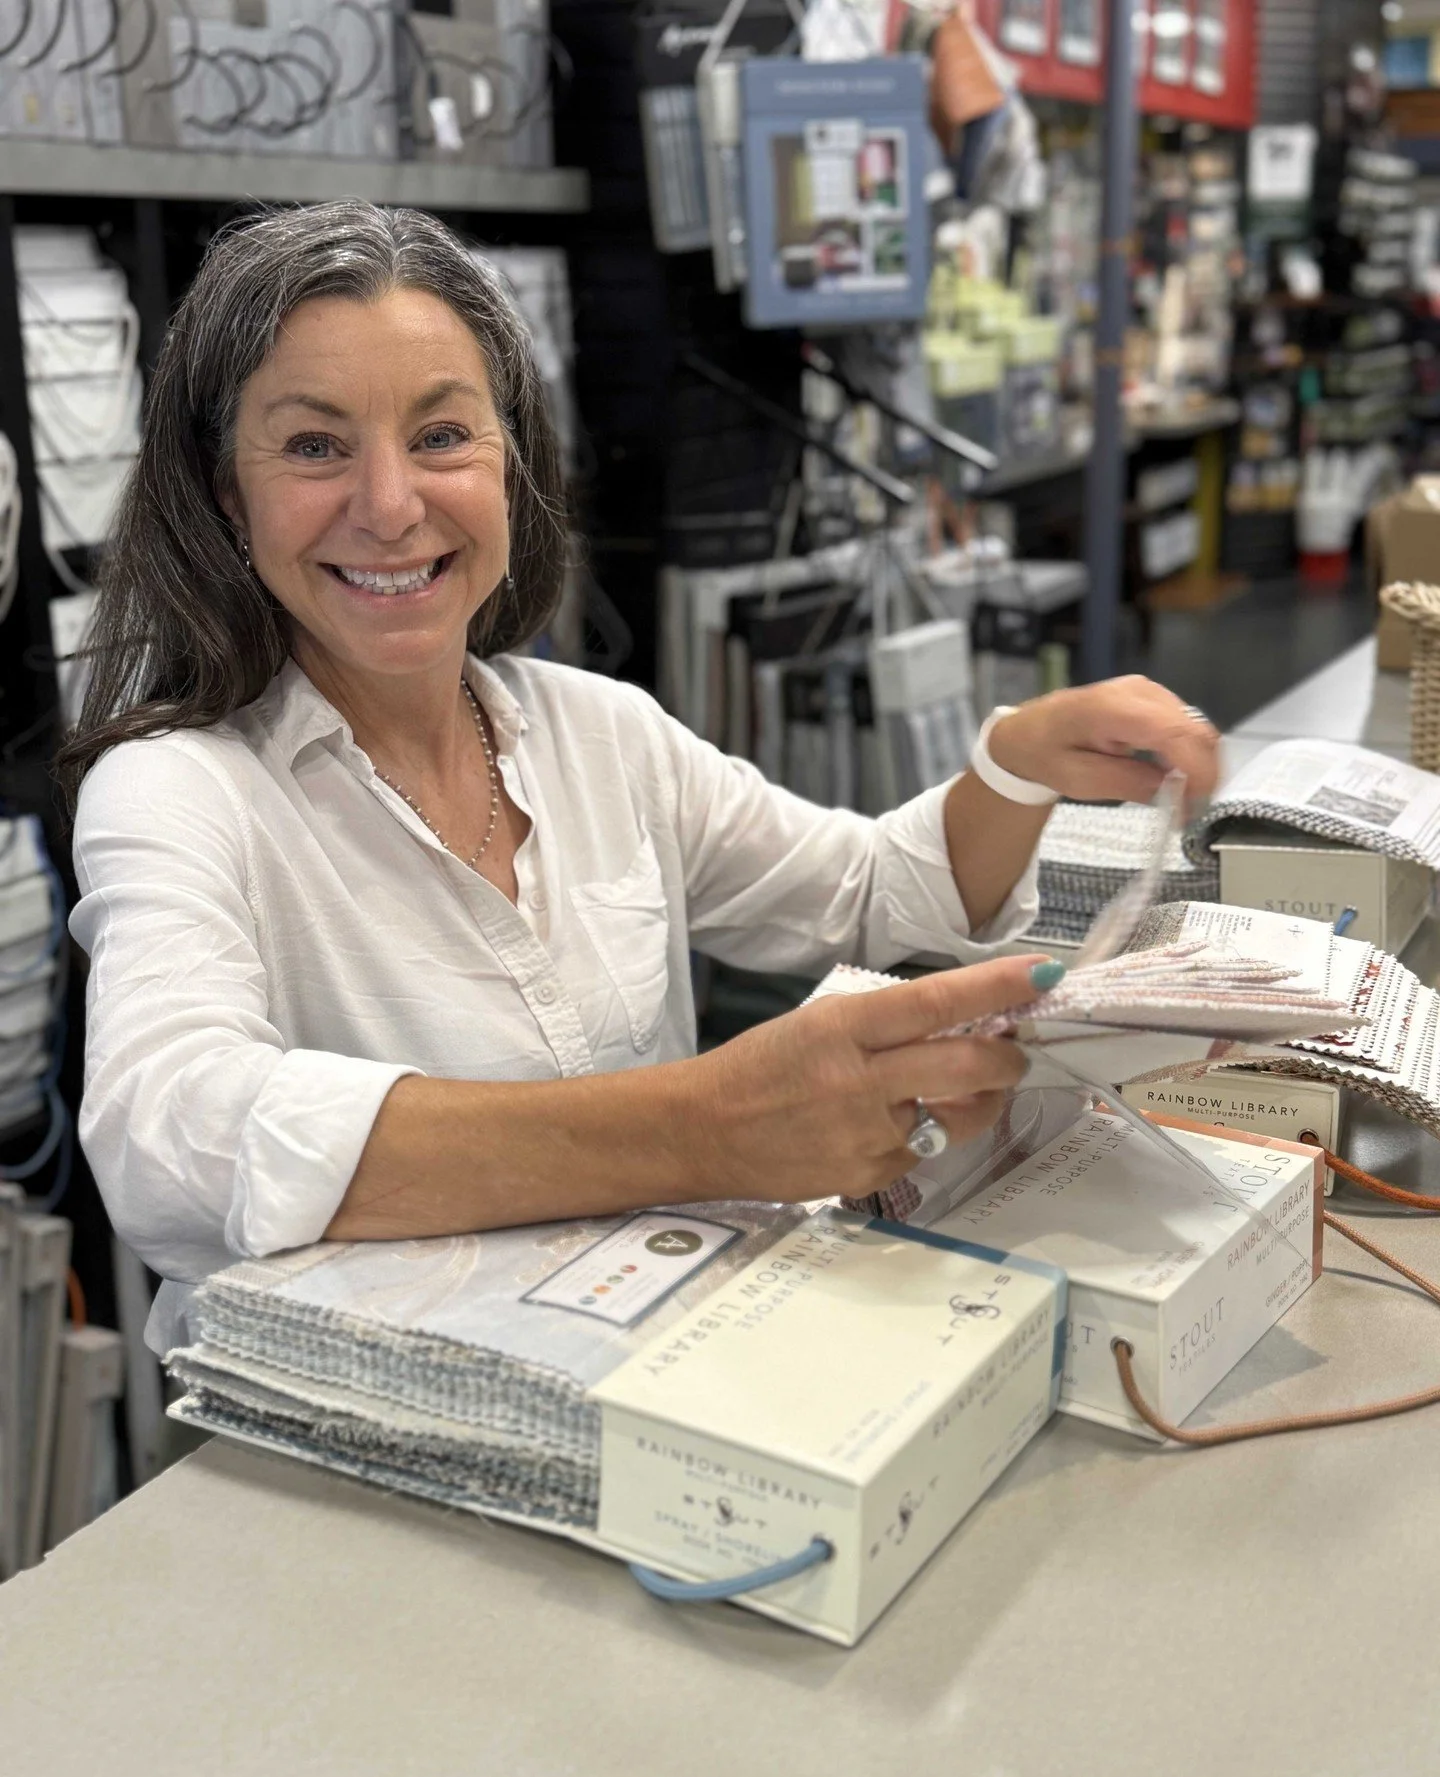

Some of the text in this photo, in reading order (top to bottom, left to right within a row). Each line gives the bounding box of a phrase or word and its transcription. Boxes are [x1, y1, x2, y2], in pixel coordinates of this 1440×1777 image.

[1264, 899, 1337, 917] STOUT
[1147, 1091, 1299, 1117] RAINBOW LIBRARY
[1187, 1107, 1255, 1120] MULTI-PURPOSE
[963, 1117, 1114, 1225] RAINBOW LIBRARY
[1039, 1123, 1135, 1196] MULTI-PURPOSE
[738, 1225, 837, 1299] RAINBOW
[1227, 1216, 1273, 1272] RAINBOW
[1274, 1179, 1311, 1226] LIBRARY
[734, 1231, 861, 1330] MULTI-PURPOSE
[643, 1302, 741, 1377] LIBRARY
[1169, 1297, 1224, 1371] STOUT
[637, 1436, 823, 1510] RAINBOW LIBRARY
